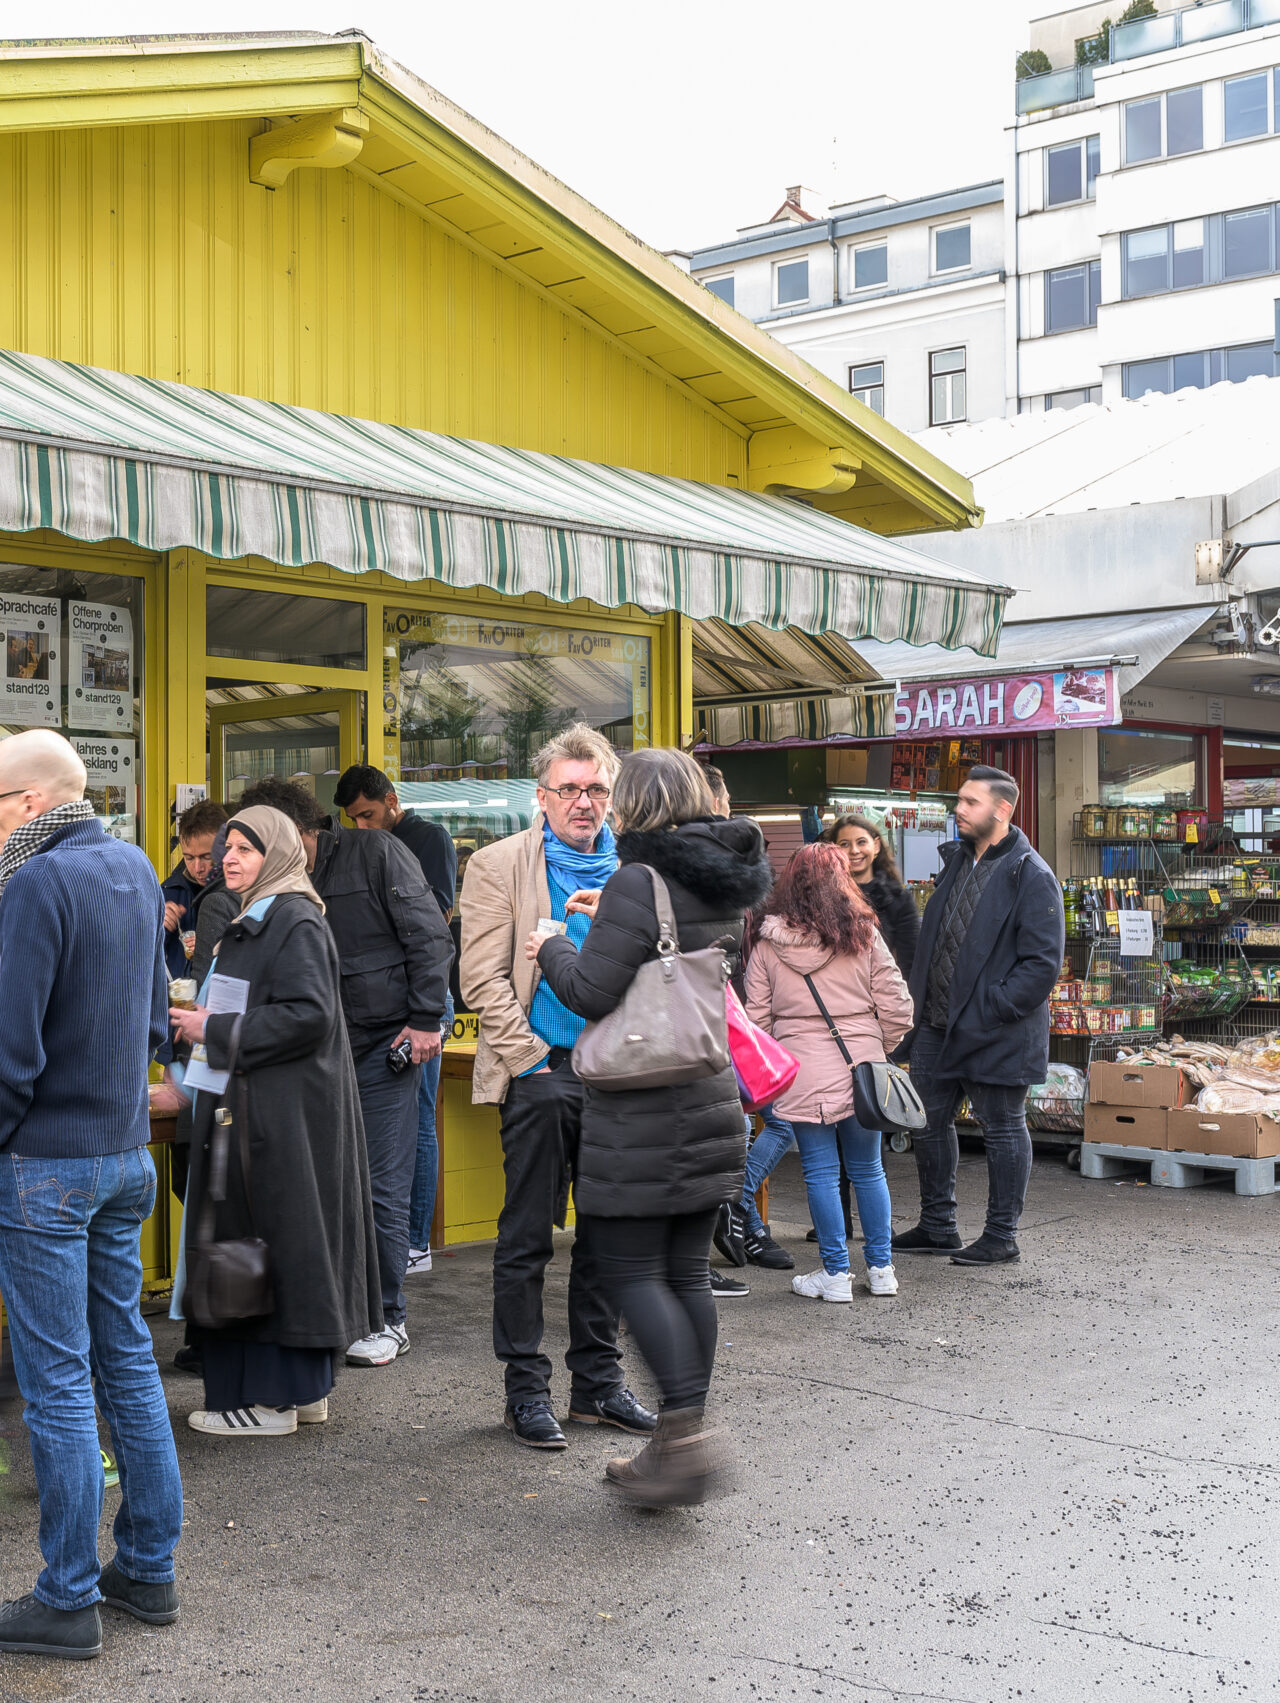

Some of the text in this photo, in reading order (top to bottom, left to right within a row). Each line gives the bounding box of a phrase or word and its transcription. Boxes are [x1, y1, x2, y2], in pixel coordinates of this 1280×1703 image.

[72, 605, 102, 619] Offene
[72, 617, 124, 635] Chorproben
[6, 682, 50, 696] stand129
[85, 693, 121, 704] stand129
[895, 682, 1005, 732] SARAH
